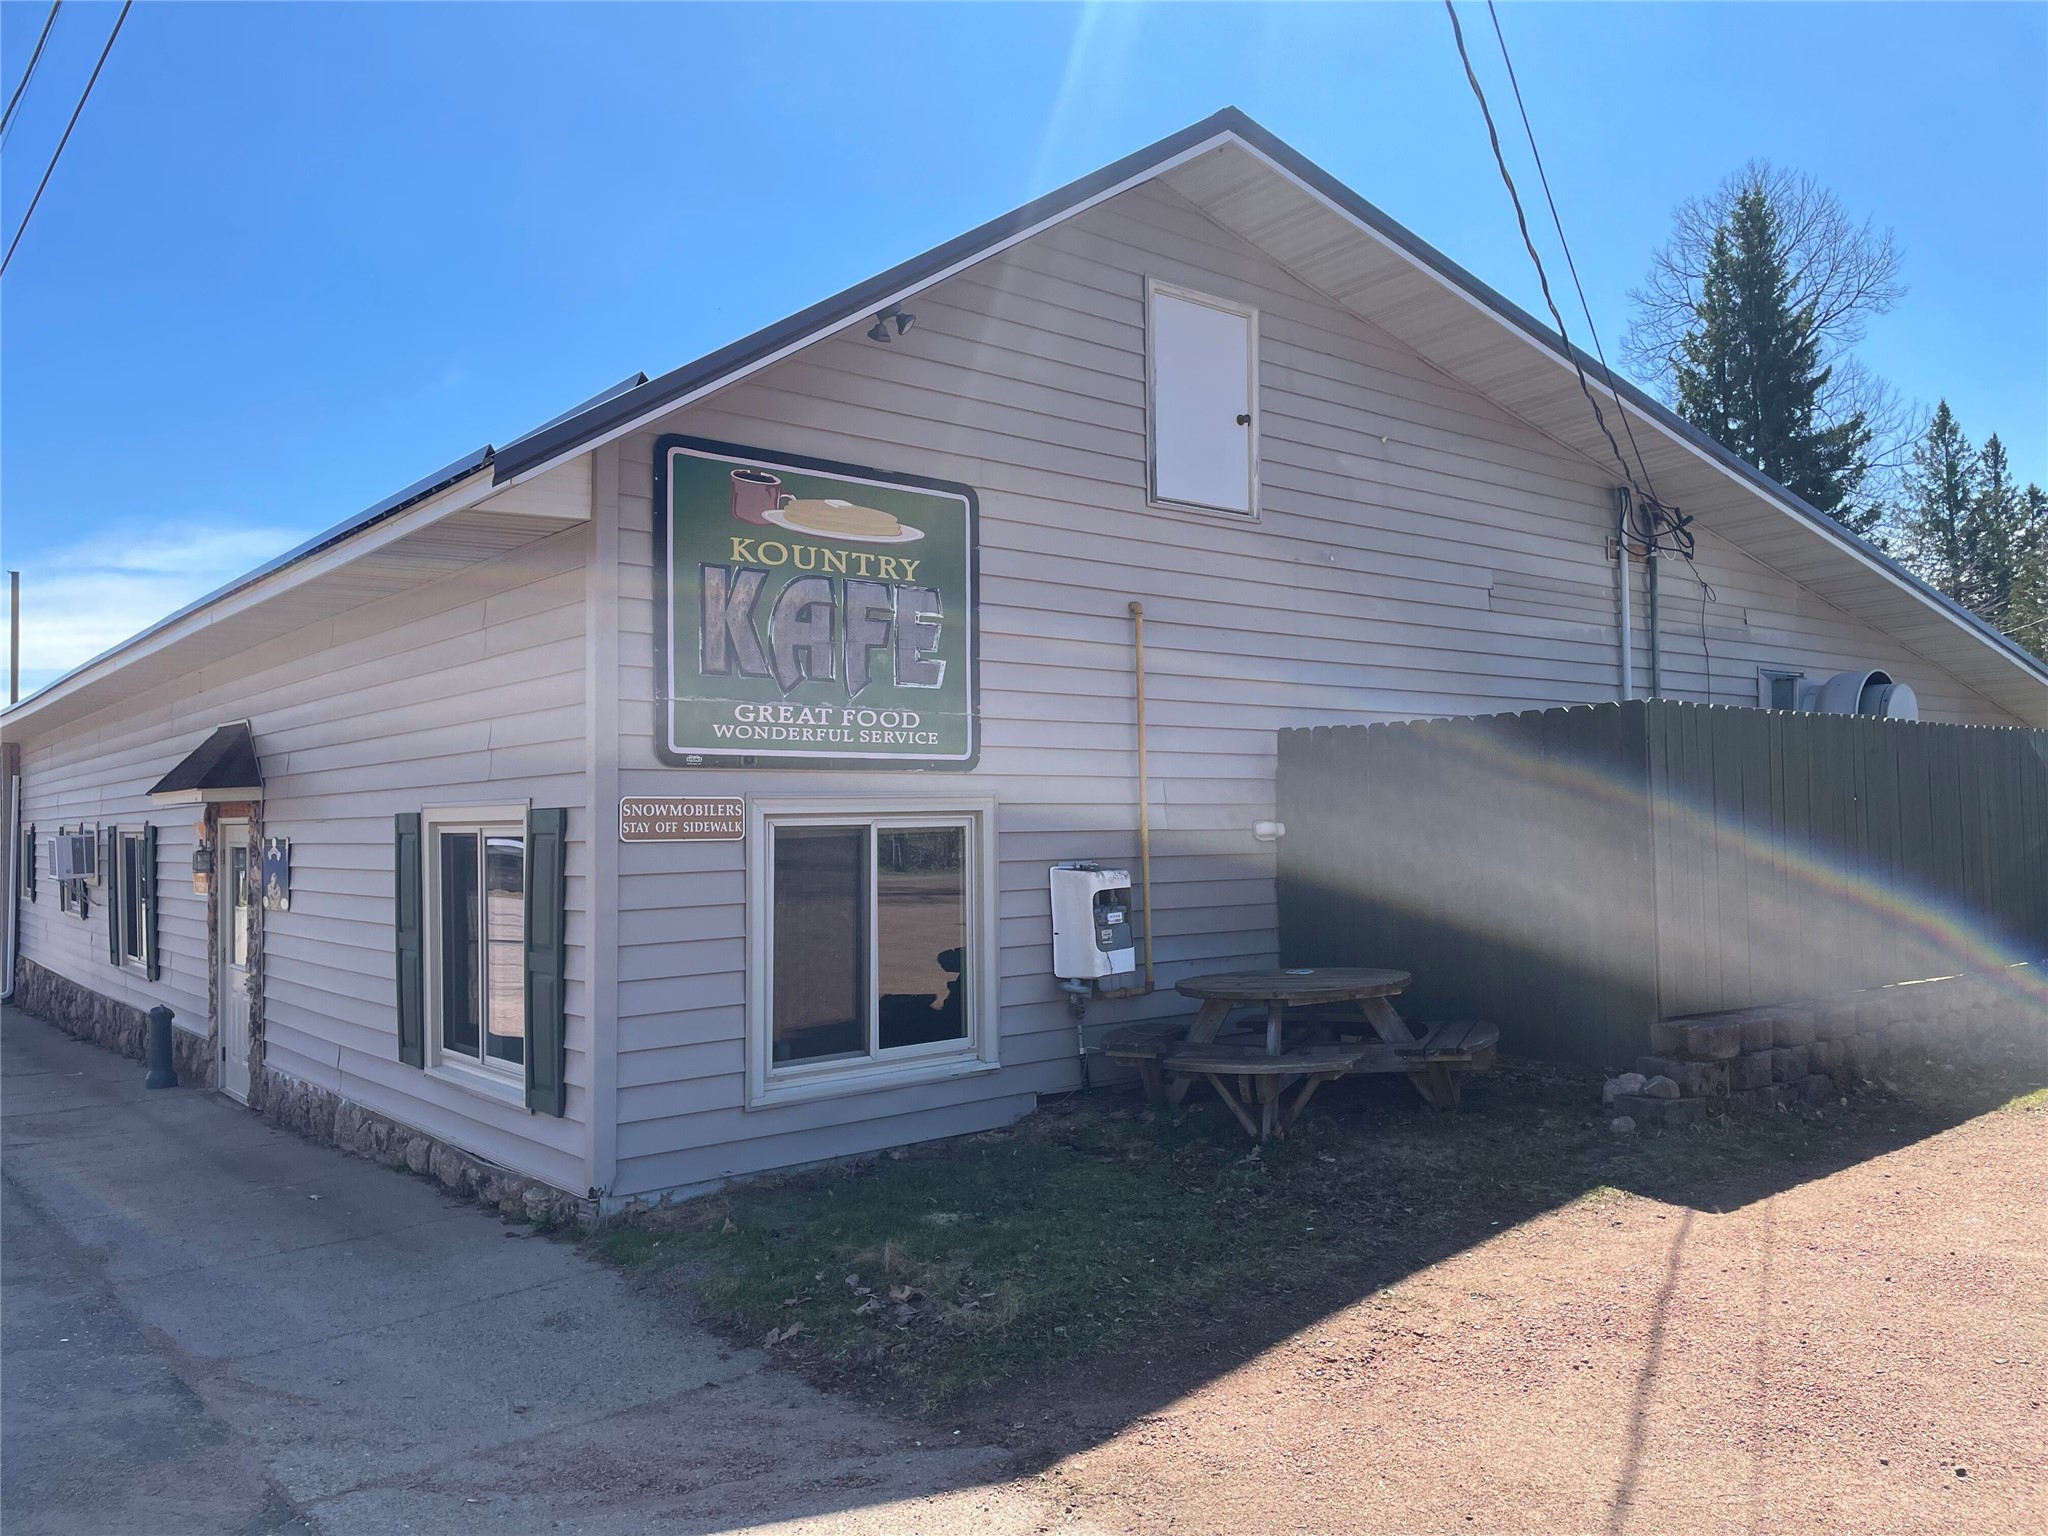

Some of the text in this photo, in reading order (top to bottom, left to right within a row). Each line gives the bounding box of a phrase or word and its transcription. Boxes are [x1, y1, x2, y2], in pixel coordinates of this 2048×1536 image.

[730, 537, 921, 582] KOUNTRY
[698, 562, 947, 699] KAFE
[734, 704, 921, 729] GREAT FOOD
[712, 724, 939, 745] WONDERFUL SERVICE
[622, 803, 743, 817] SNOWMOBILERS
[622, 821, 743, 834] STAY OFF SIDEWALK
